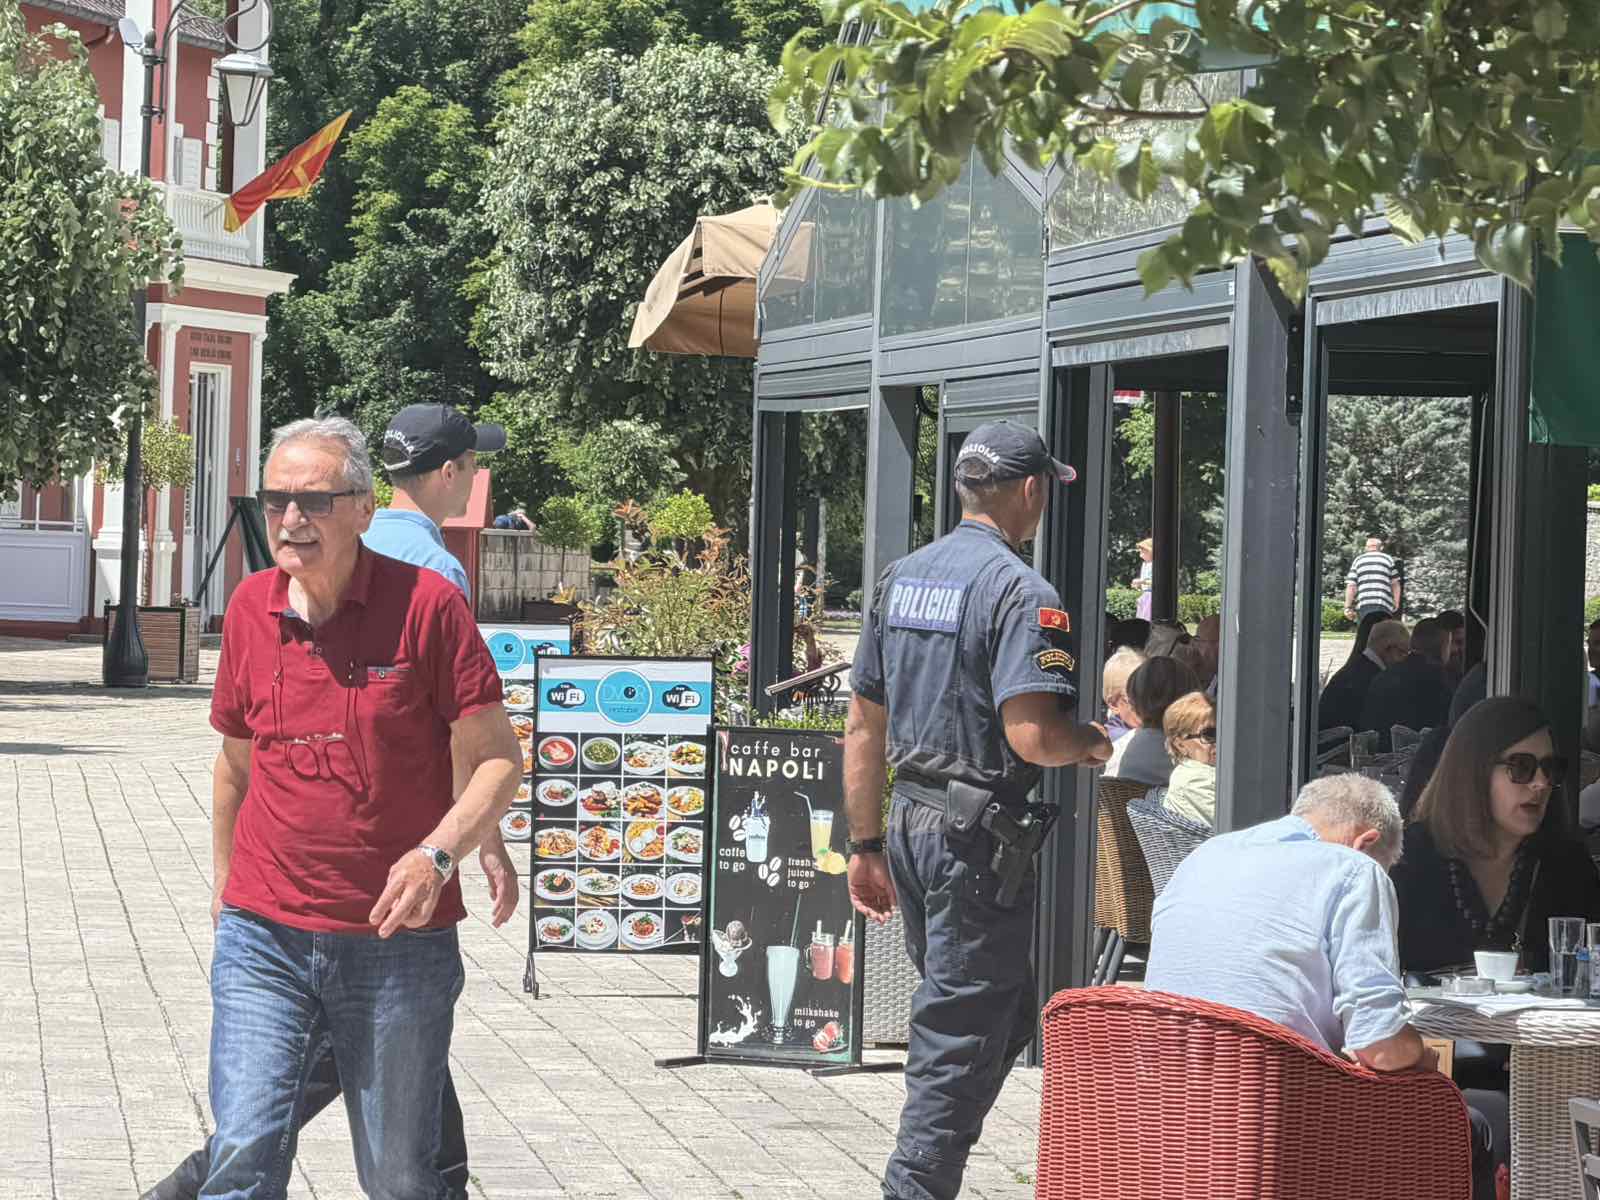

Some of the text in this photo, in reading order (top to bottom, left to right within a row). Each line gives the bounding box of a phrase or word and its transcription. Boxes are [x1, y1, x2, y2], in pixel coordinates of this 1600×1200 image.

[889, 583, 961, 622] POLICIJA
[730, 740, 820, 758] caffe bar
[729, 757, 824, 780] NAPOLI
[719, 860, 745, 873] to go
[788, 857, 811, 867] fresh
[787, 868, 815, 879] juices
[787, 879, 810, 890] to go
[794, 1007, 840, 1018] milkshake
[794, 1018, 816, 1030] to go
